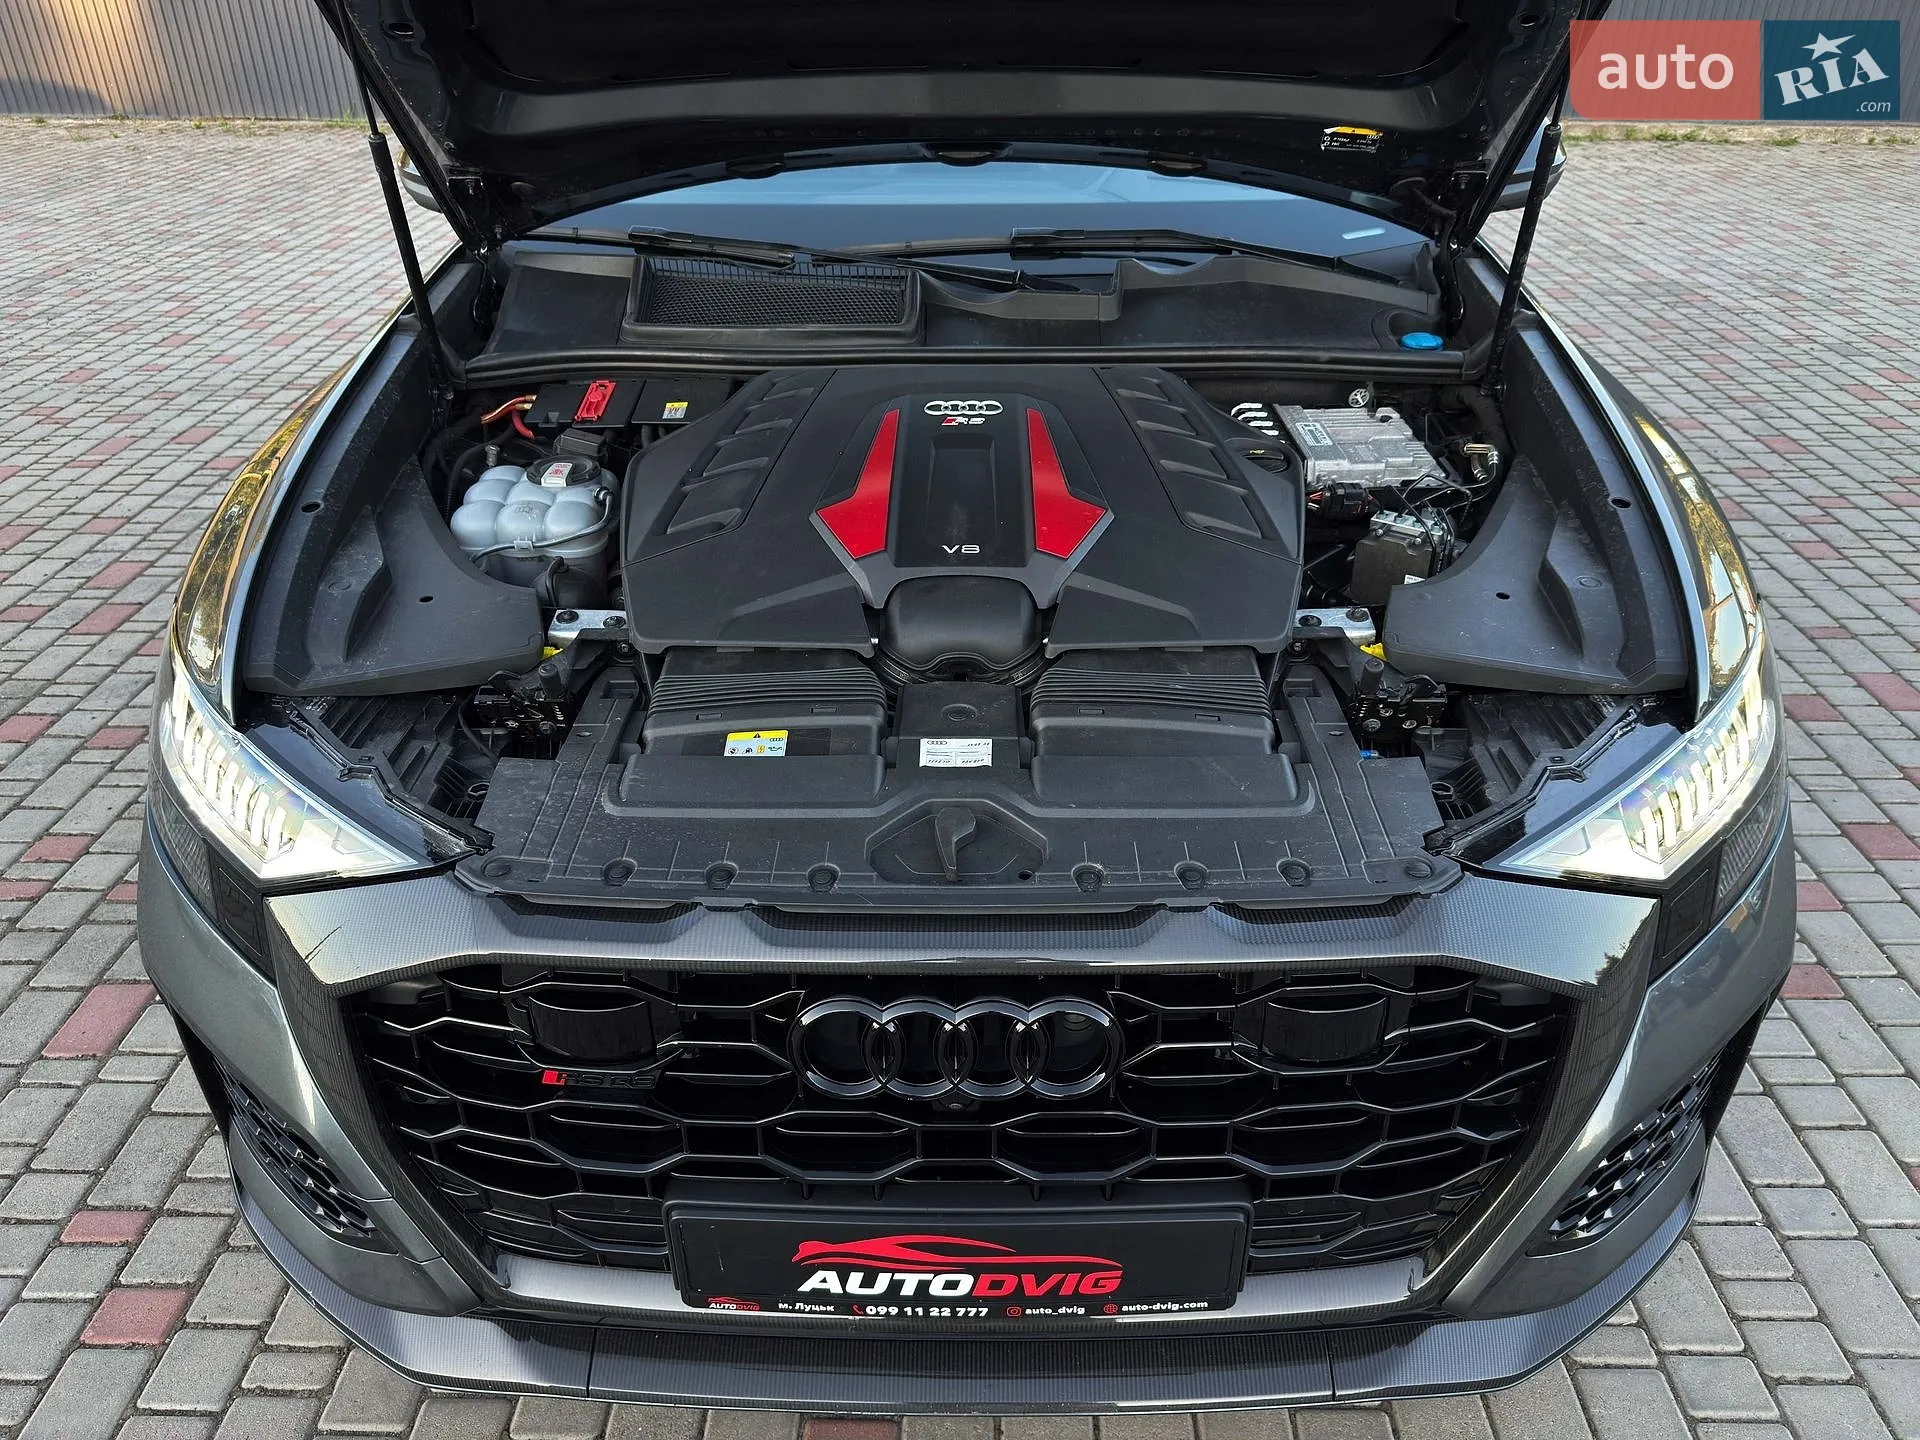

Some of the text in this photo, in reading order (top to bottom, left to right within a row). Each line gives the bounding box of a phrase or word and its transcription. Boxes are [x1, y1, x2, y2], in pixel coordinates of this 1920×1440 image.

[942, 544, 980, 554] V8
[797, 1269, 1123, 1297] AUTODVIG
[795, 1302, 835, 1313] Луцьк
[865, 1305, 989, 1317] 099 11 22 777
[1025, 1305, 1086, 1315] auto_dvig
[1121, 1300, 1209, 1312] auto-dvig.com
